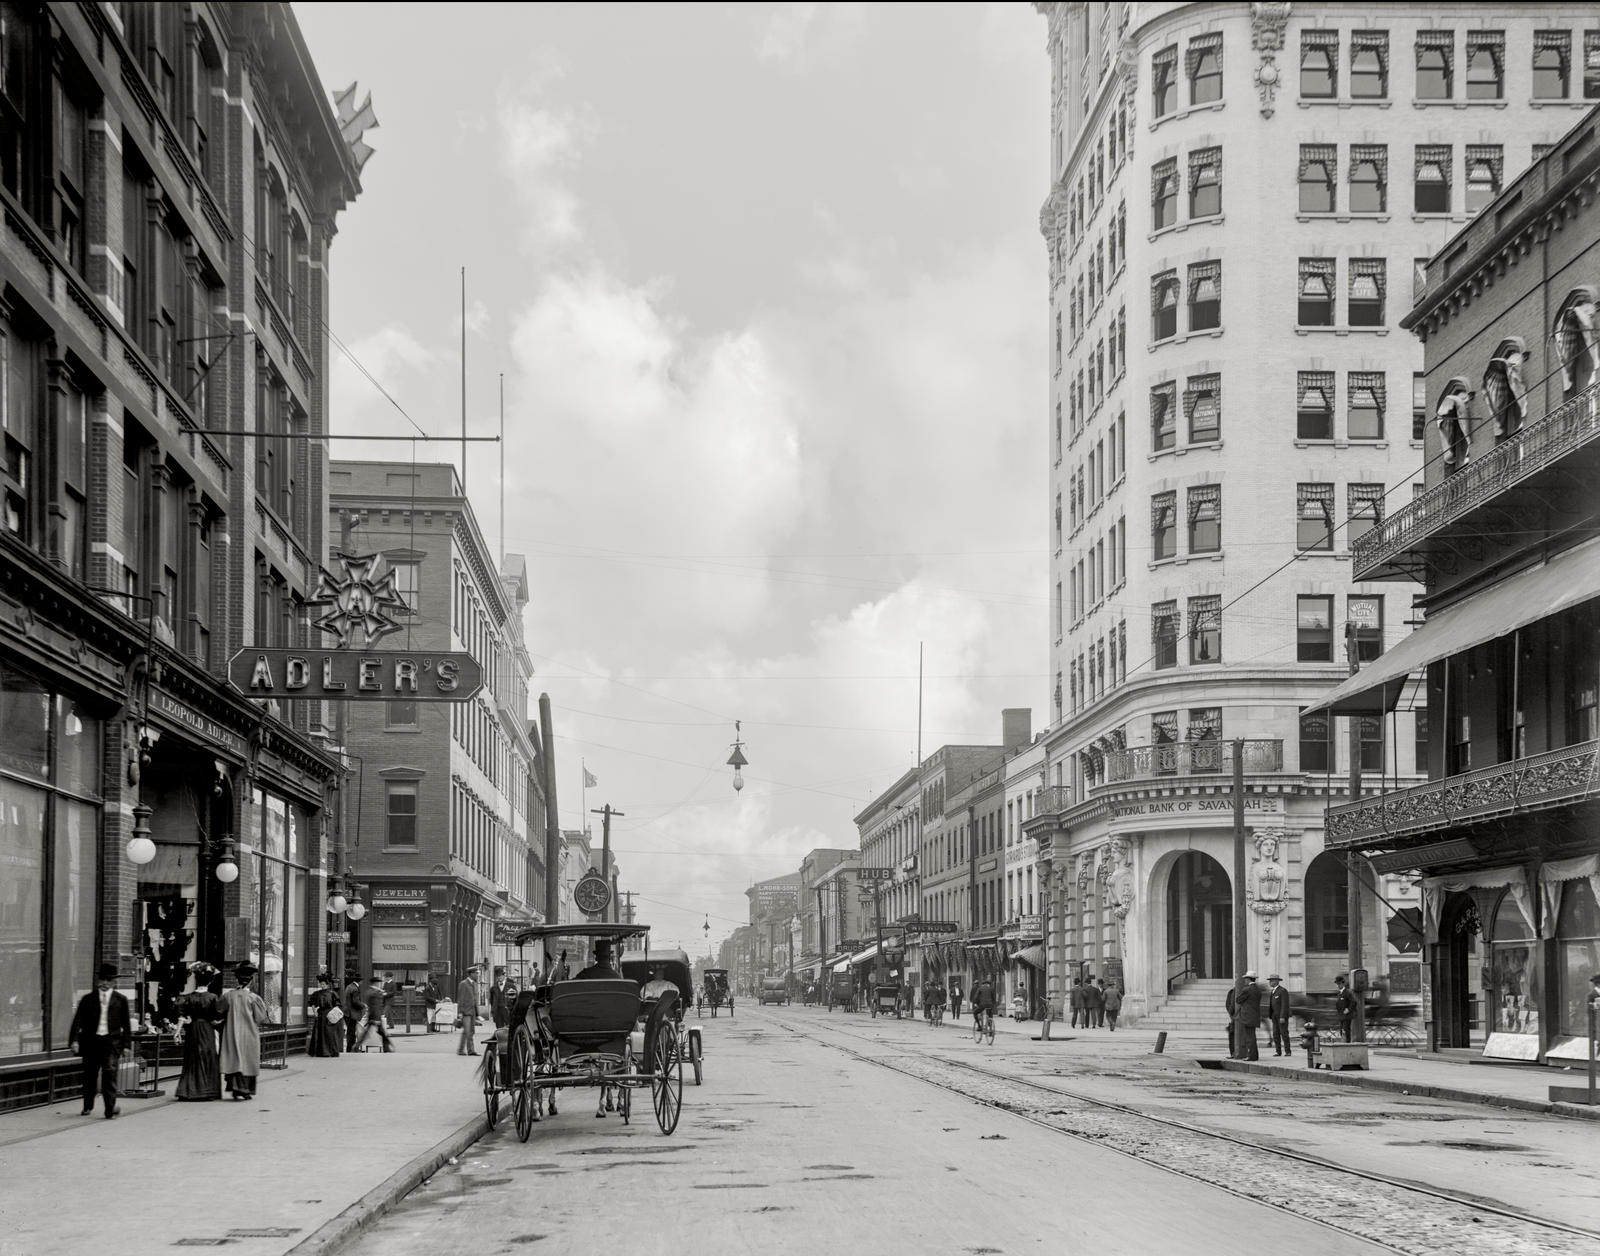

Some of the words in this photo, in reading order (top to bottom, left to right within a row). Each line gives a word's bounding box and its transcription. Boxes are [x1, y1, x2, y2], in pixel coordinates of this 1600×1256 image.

[1350, 602, 1376, 613] MUTUAL
[249, 655, 460, 692] ADLER'S
[161, 696, 204, 730] LEOPOLD
[1115, 805, 1145, 818] NATIONAL
[1149, 802, 1174, 813] BANK
[1178, 801, 1193, 811] OF
[1199, 799, 1260, 811] SAVANAH
[861, 869, 890, 879] HUB
[375, 889, 427, 897] JEWELRY.
